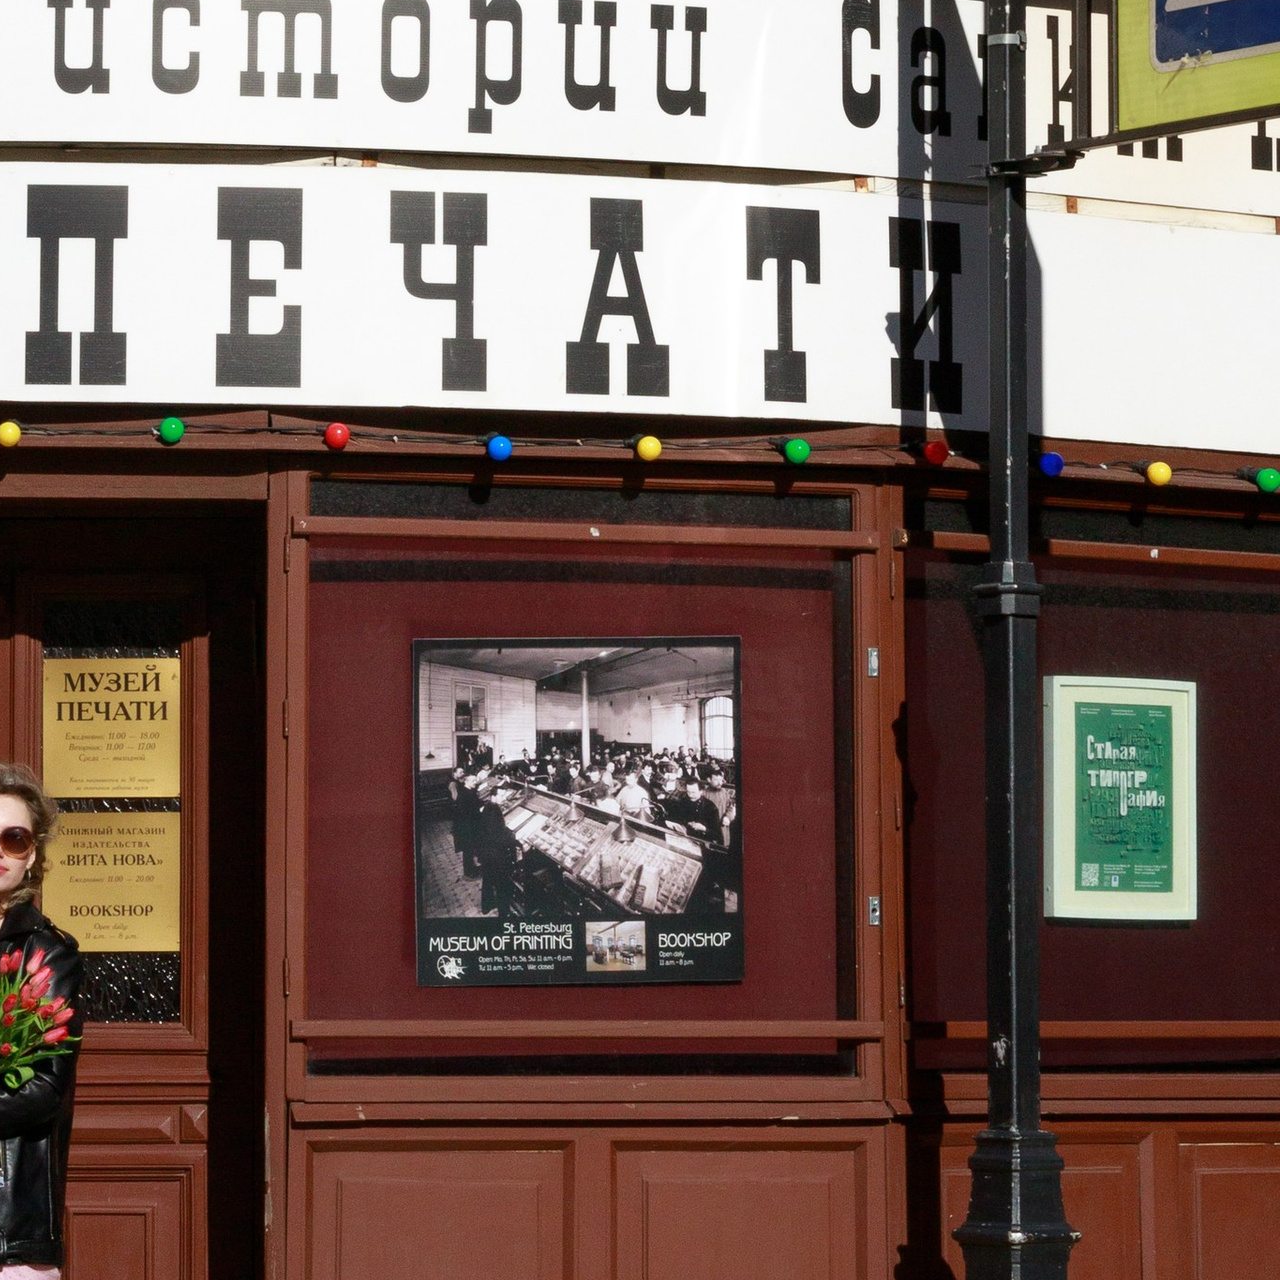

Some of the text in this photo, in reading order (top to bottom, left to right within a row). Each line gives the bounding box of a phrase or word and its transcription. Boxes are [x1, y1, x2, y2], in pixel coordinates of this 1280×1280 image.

[24, 183, 963, 415] ПЕЧАТИ
[63, 664, 161, 693] МУЗЕЙ
[56, 701, 169, 721] ПЕЧАТИ
[69, 904, 154, 917] BOOKSHOP
[503, 923, 573, 935] St. Petersburg
[429, 934, 573, 952] MUSEUM OF PRINTING
[658, 933, 731, 948] BOOKSHOP
